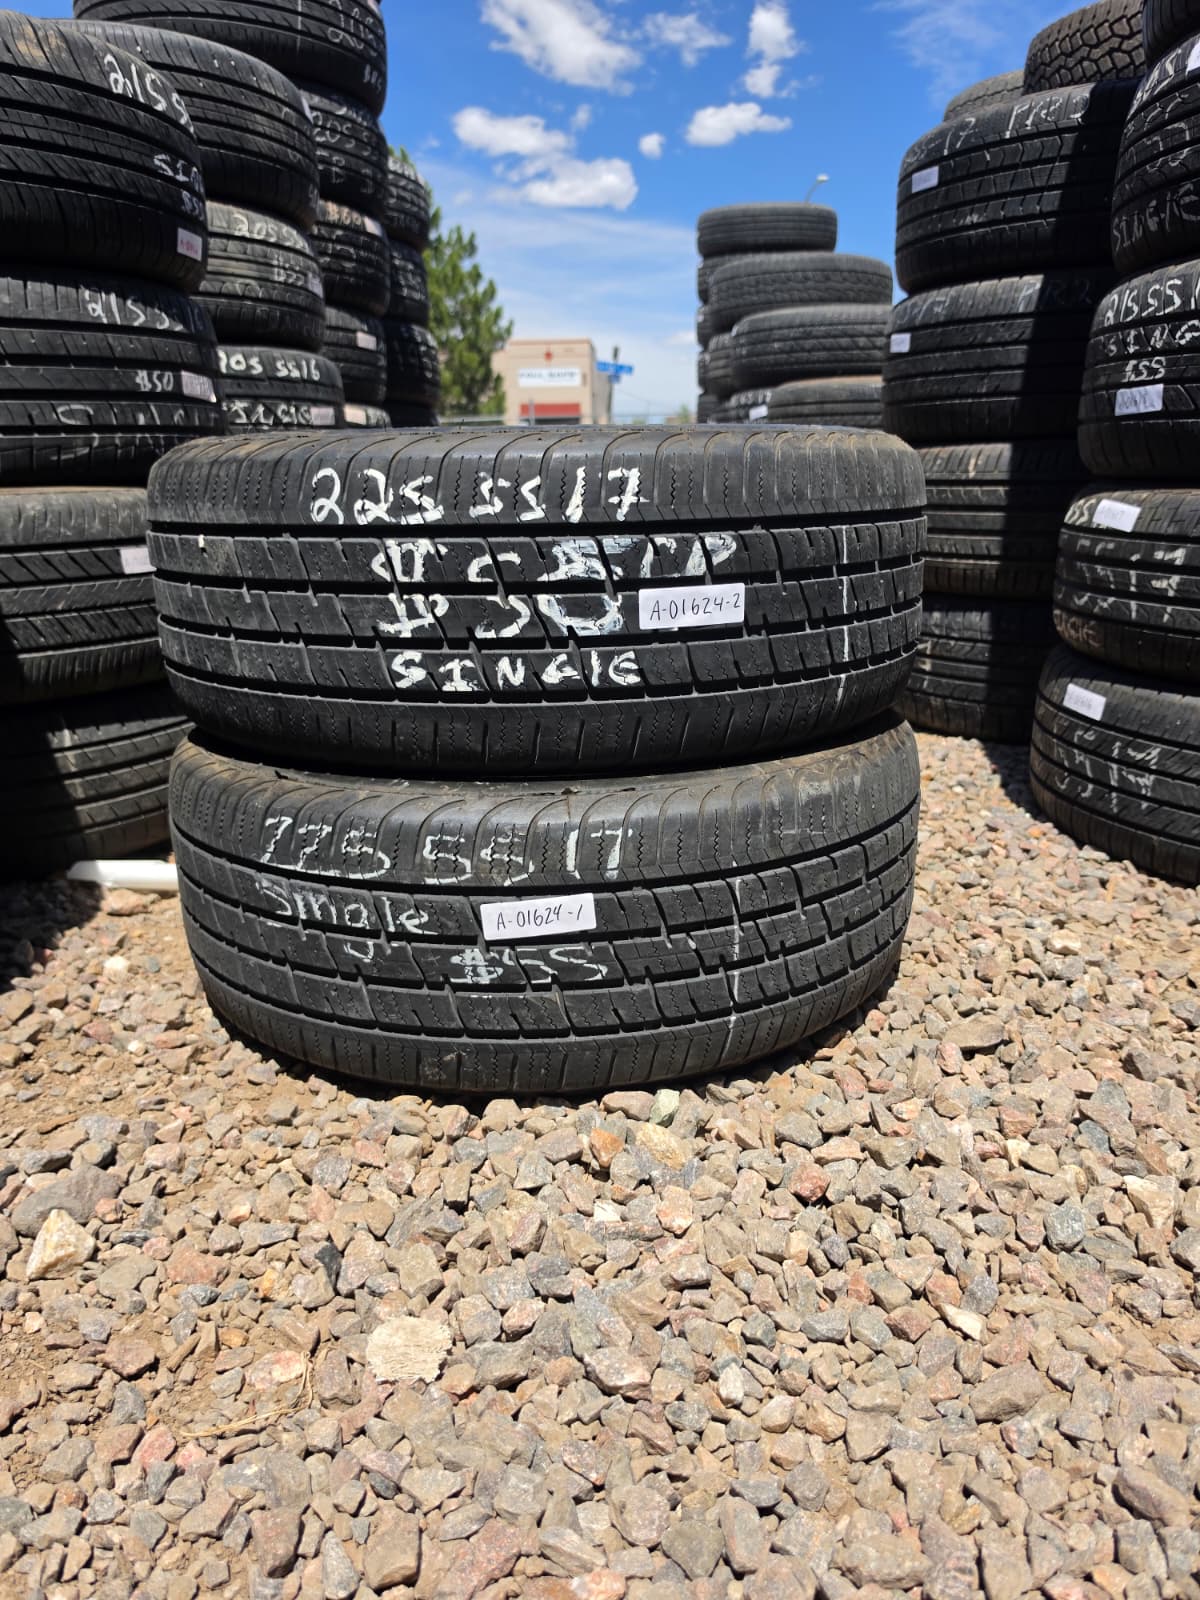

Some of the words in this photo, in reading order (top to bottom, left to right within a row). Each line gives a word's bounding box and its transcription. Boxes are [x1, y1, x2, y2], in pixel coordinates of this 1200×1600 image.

[310, 467, 444, 527] 225
[649, 592, 741, 621] A-01624-2
[565, 826, 634, 881] 17
[496, 903, 583, 932] A-01624-1
